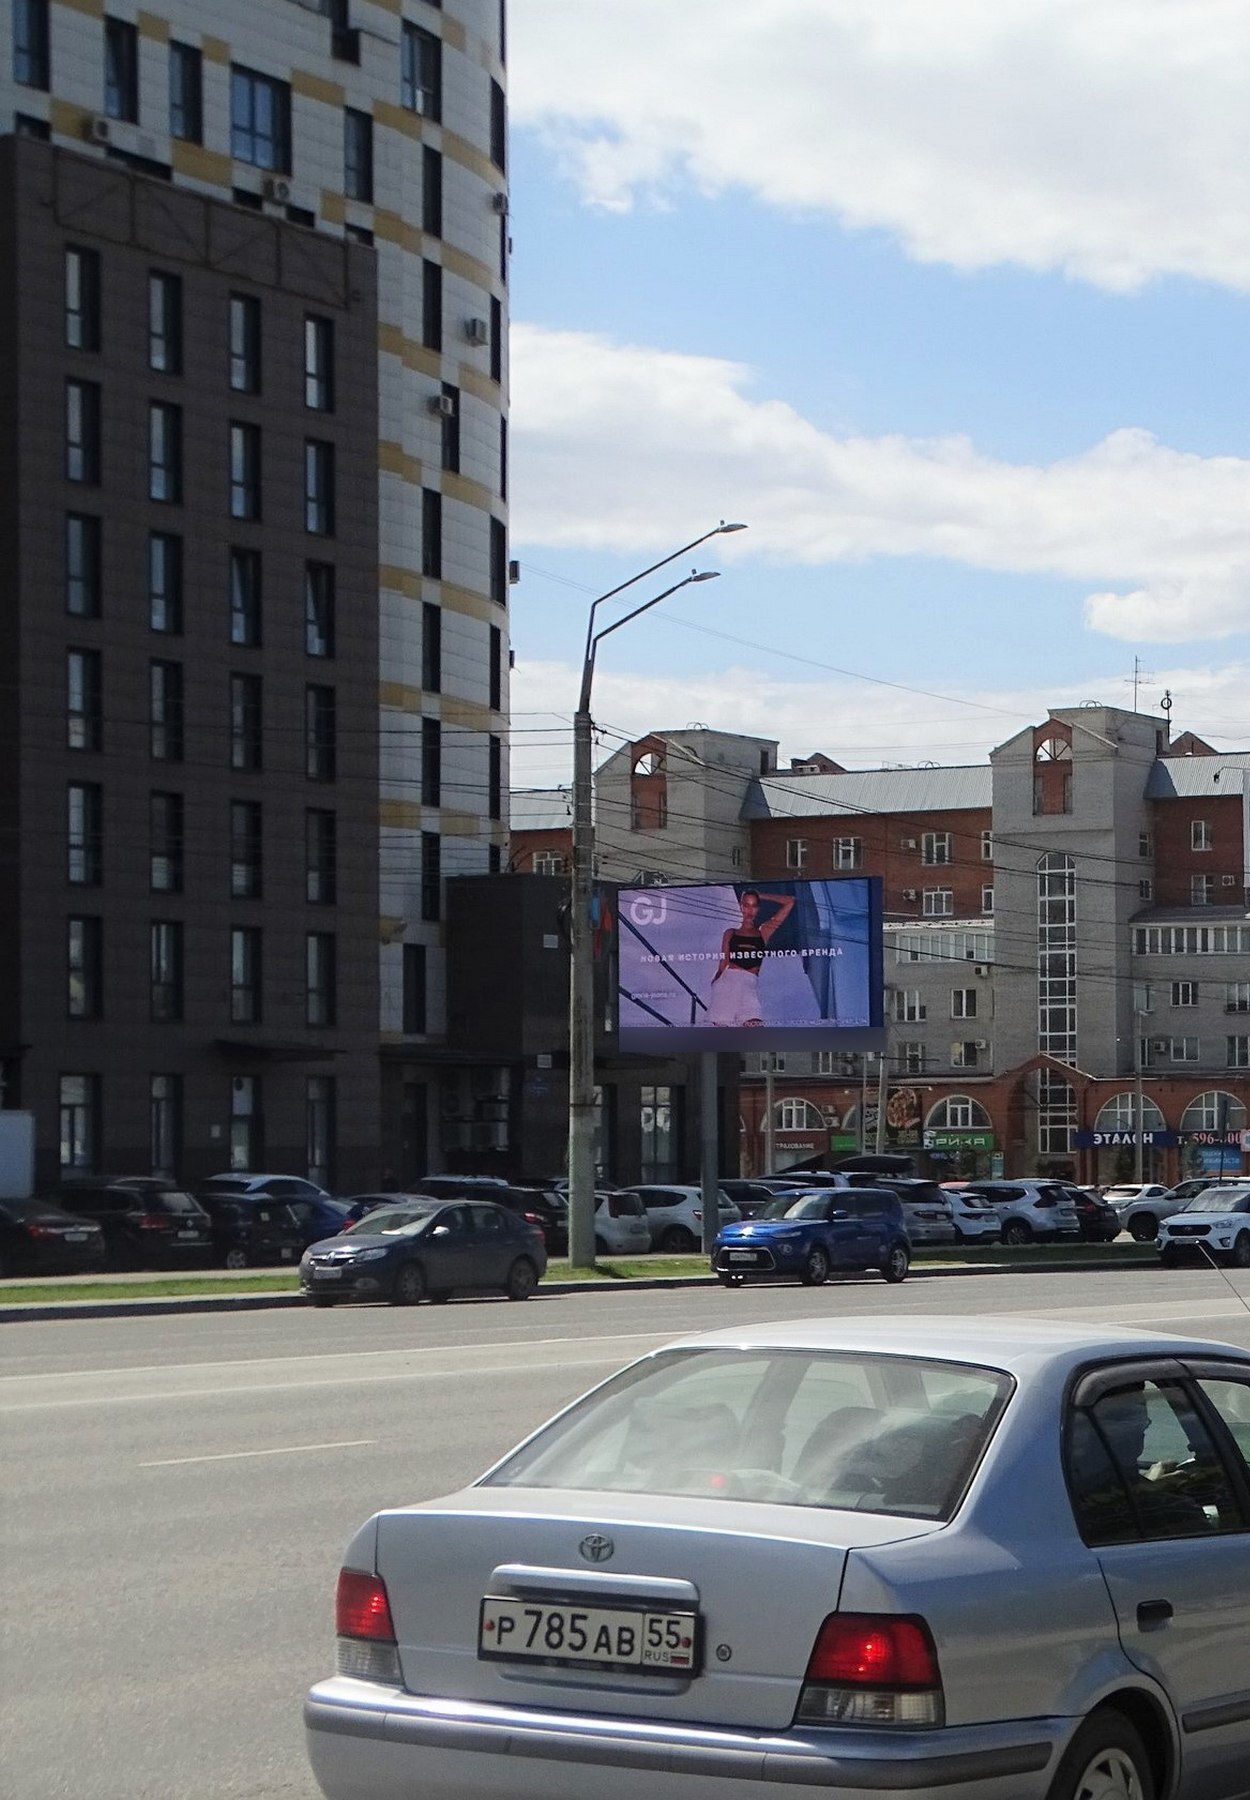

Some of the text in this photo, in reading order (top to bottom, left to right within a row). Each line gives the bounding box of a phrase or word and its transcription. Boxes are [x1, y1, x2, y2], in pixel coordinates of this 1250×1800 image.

[630, 896, 667, 926] GJ
[640, 947, 844, 963] НОВАЯ ИСТОРИЯ ИЗВЕСТНОГО БРЕНДА
[1192, 1132, 1241, 1145] 596-00
[647, 1618, 682, 1650] 55
[644, 1651, 670, 1664] RUS
